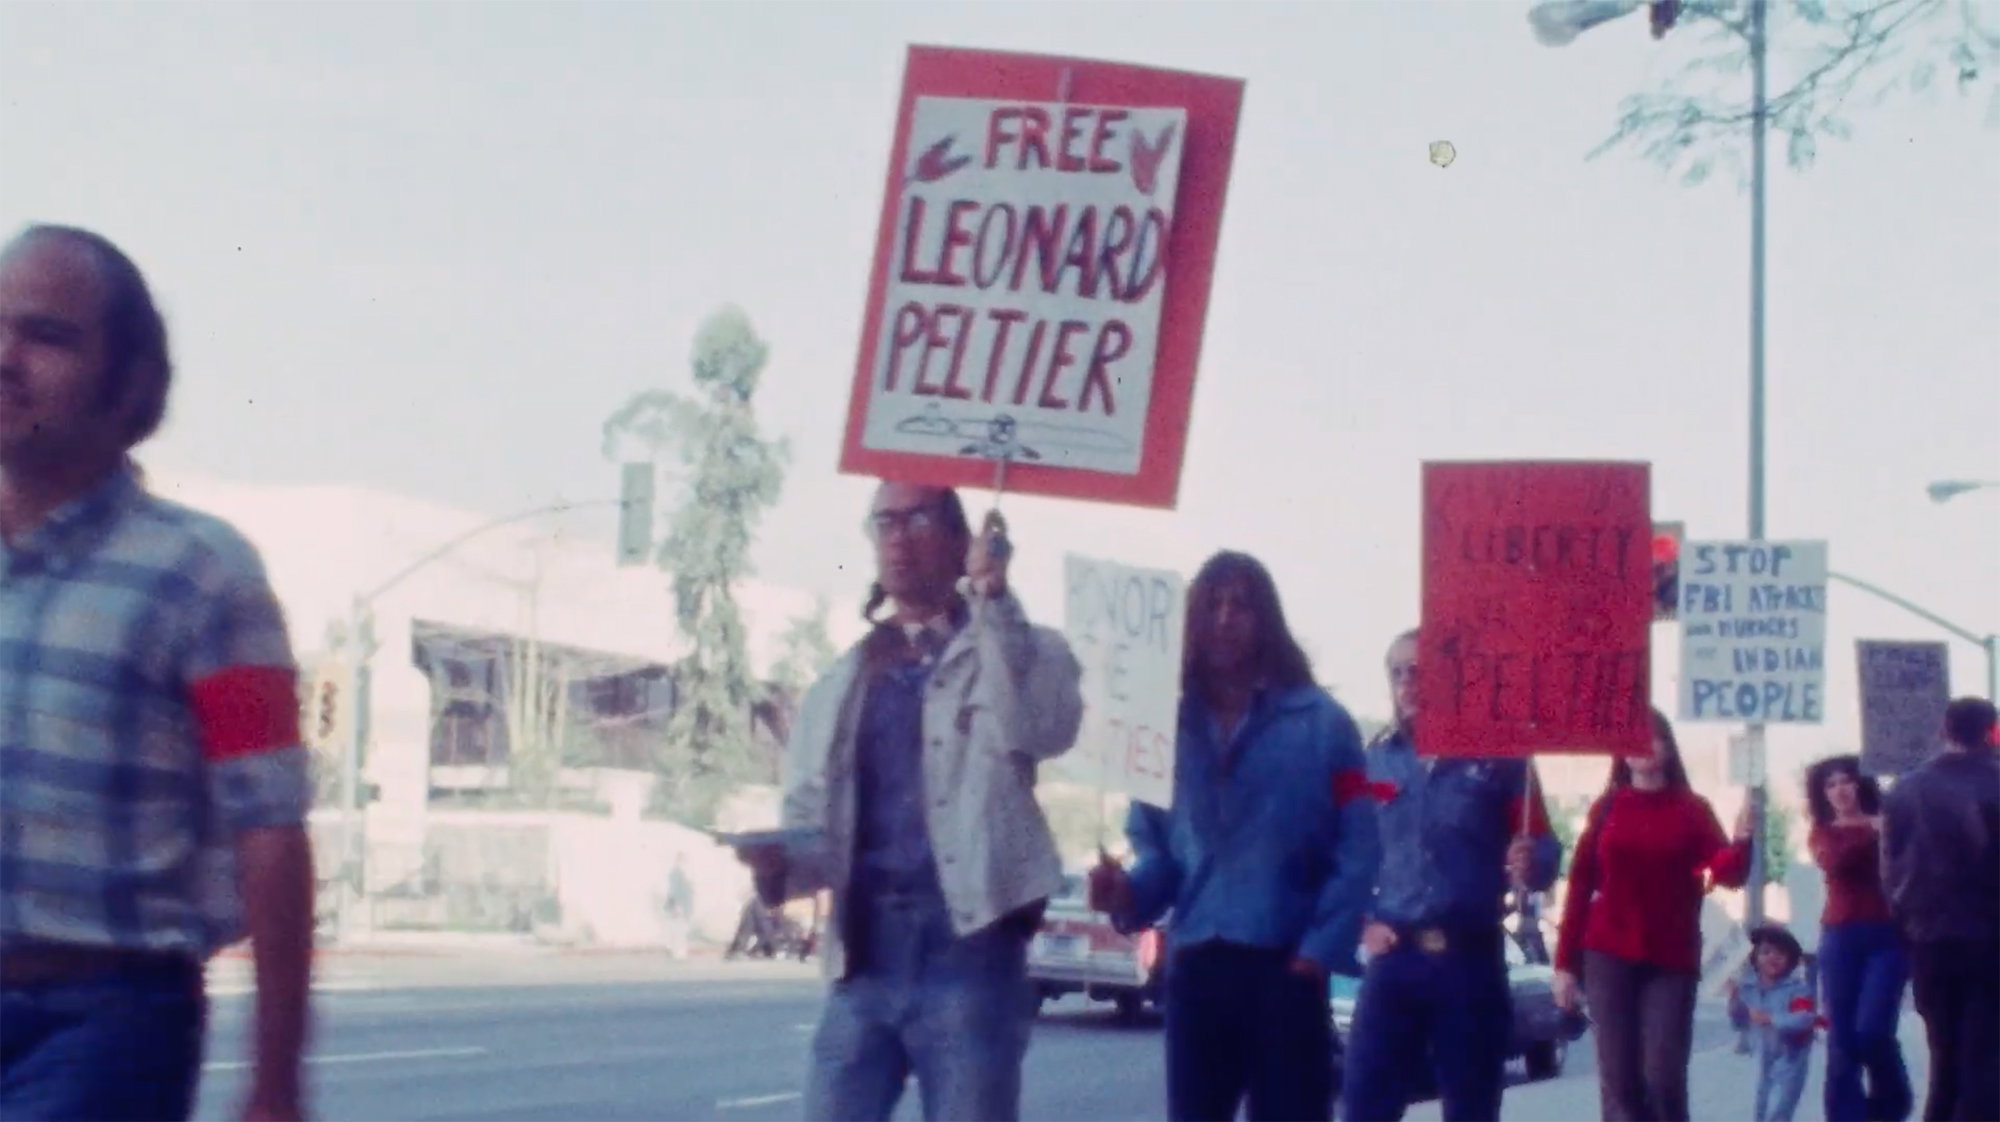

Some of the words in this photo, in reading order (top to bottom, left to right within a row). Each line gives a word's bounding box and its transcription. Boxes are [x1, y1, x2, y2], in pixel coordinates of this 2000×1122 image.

[982, 106, 1129, 173] FREE
[899, 195, 1168, 304] LEONARD
[882, 300, 1133, 416] PELTIER
[1461, 523, 1633, 582] LIBERTY
[1694, 545, 1791, 577] STOP
[1684, 583, 1732, 613] FBI
[1732, 648, 1823, 673] INDIAN
[1692, 679, 1819, 722] PEOPLE
